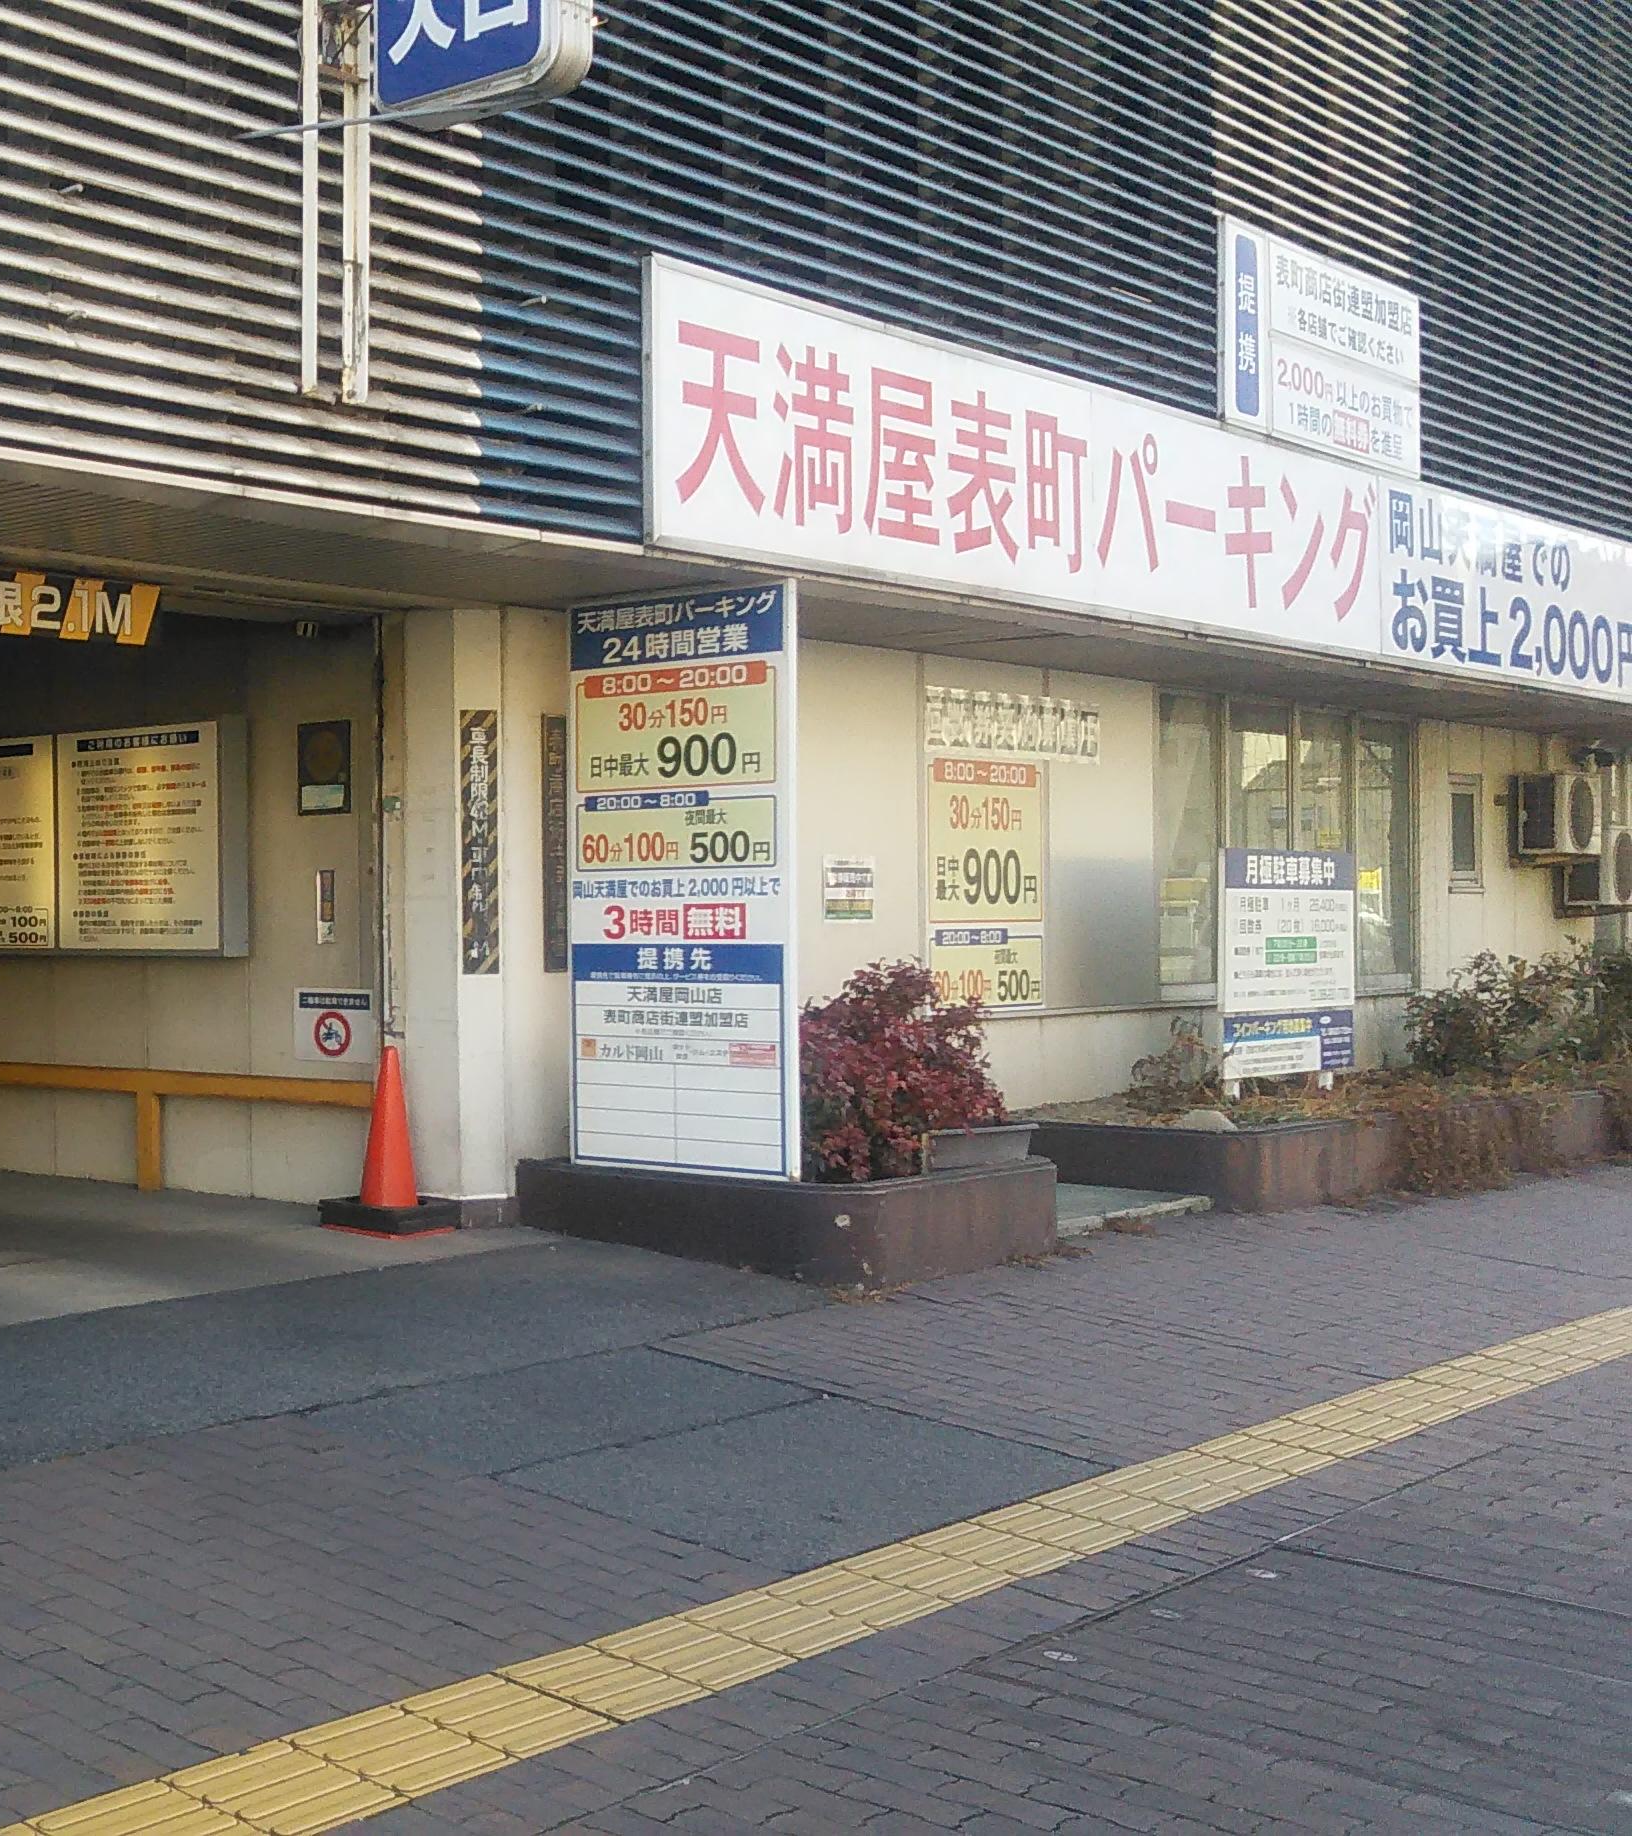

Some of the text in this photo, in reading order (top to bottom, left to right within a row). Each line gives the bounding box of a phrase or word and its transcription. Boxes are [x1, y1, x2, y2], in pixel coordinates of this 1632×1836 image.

[1276, 255, 1413, 337] 表町商店街連盟加盟店
[1237, 272, 1257, 375] 提携
[676, 320, 1376, 623] 天満屋表町パーキング
[577, 591, 777, 634] 天満屋表町パーキング
[602, 623, 749, 664] 24時間営業
[618, 697, 728, 731] 30分150円
[684, 809, 727, 826] 夜間最大
[582, 831, 680, 864] 60分100円
[689, 830, 771, 863] 500円
[963, 848, 1038, 905] 900円
[1245, 855, 1336, 886] 月極駐車募集中
[636, 947, 713, 970] 提携先
[626, 986, 723, 1004] 天満屋岡山店
[997, 969, 1041, 1001] 500円
[603, 1009, 749, 1028] 表町商店街連盟加盟店
[599, 1043, 664, 1061] カルド岡山
